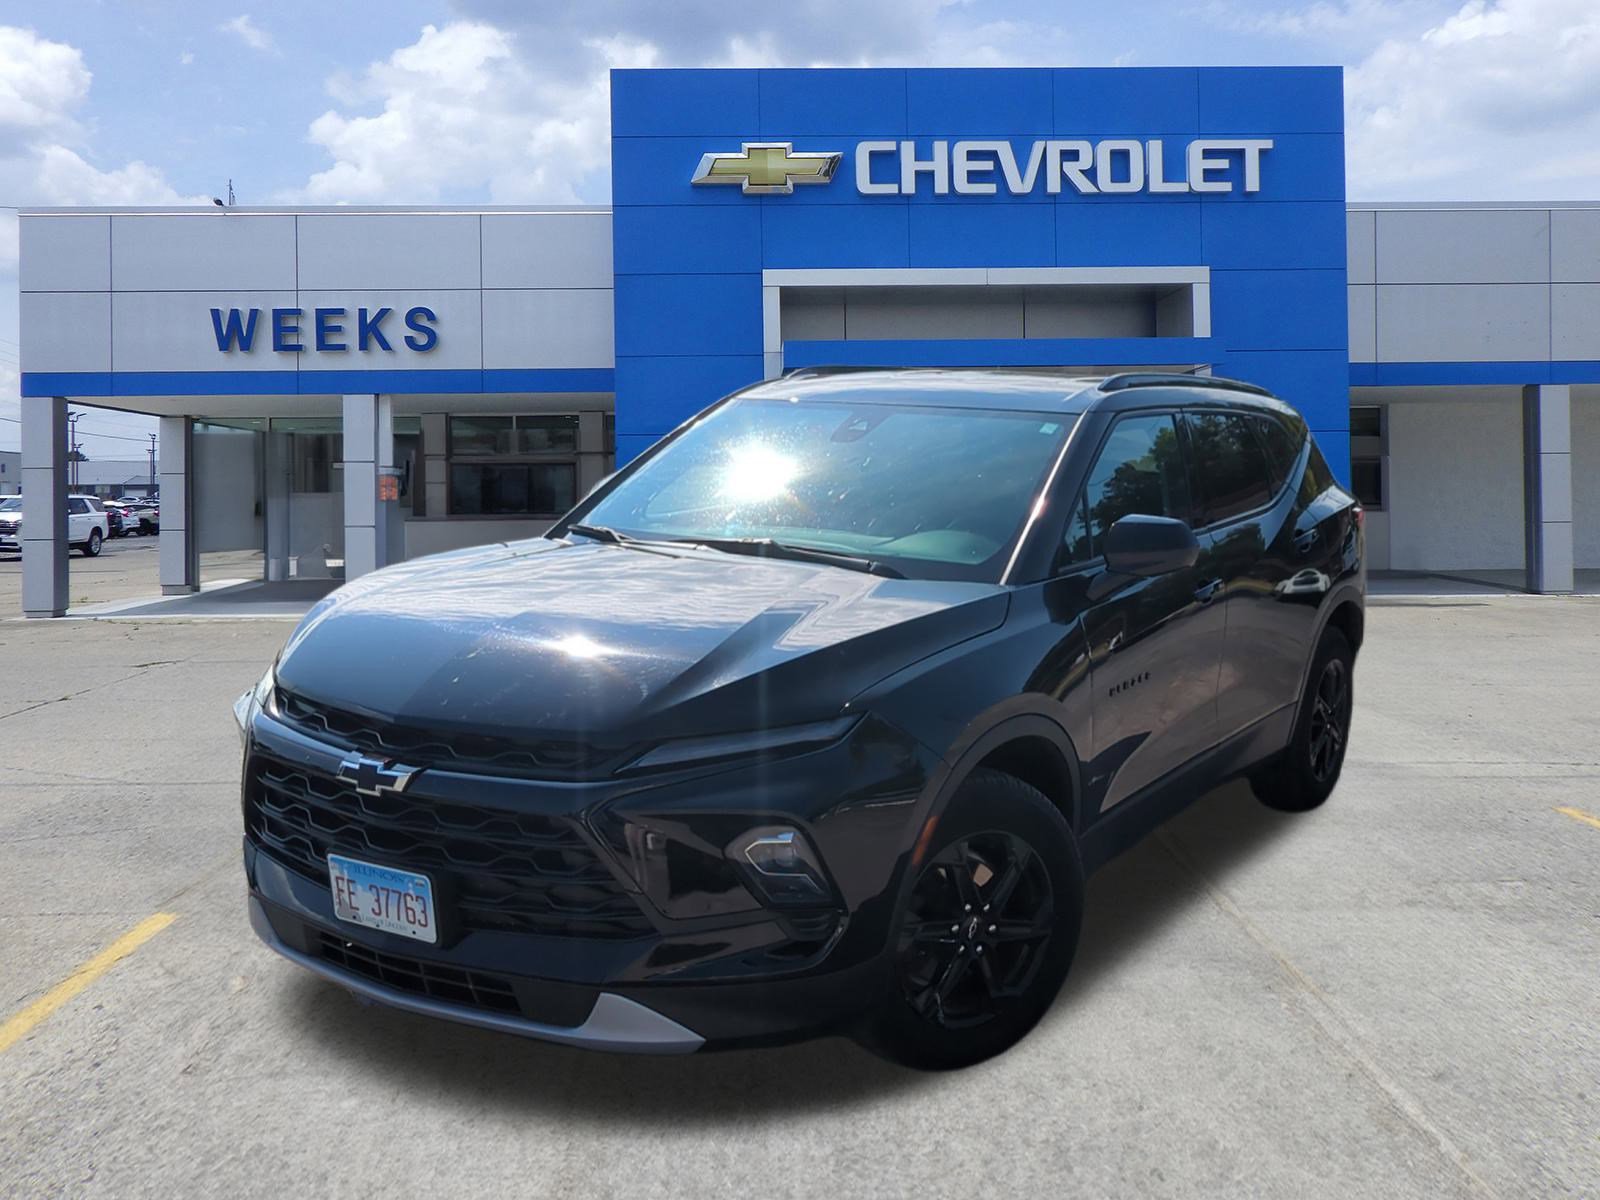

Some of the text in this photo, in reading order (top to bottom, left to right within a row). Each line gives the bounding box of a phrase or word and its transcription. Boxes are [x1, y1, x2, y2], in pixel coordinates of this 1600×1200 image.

[855, 139, 1274, 194] CHEVROLET
[209, 306, 438, 352] WEEKS
[335, 875, 360, 911] FE
[368, 884, 429, 928] 37763
